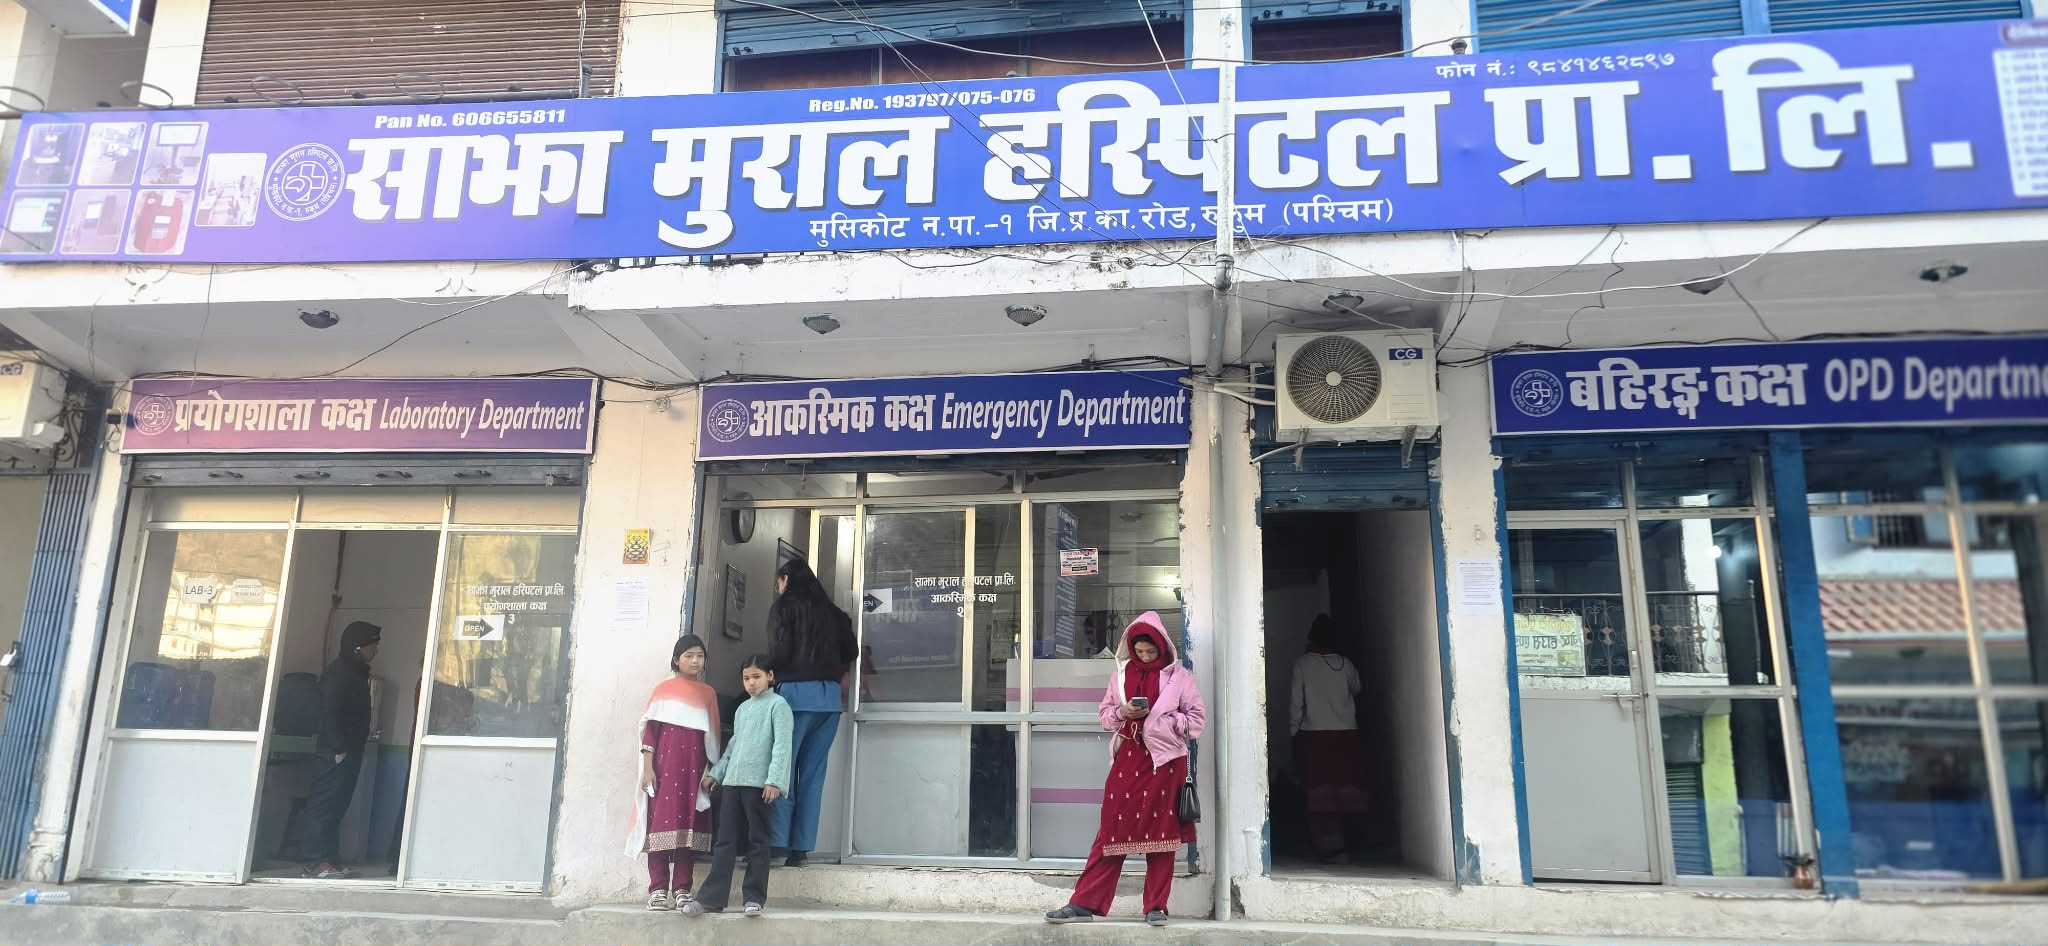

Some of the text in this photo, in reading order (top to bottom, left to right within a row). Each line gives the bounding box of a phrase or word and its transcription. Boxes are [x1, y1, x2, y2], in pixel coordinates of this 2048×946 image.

[1435, 60, 1477, 80] फोन
[1527, 52, 1676, 76] ९८४१४६२८९७
[808, 88, 1037, 113] Reg.No. 193797/075-076
[375, 109, 567, 129] Pan No. 606655811
[650, 115, 952, 250] मुराल
[978, 80, 1451, 200] हस्पिटल
[1484, 80, 1692, 186] प्रा.
[1711, 42, 1975, 172] लि.
[809, 211, 907, 240] मुसिकोट
[1282, 194, 1395, 226] (पश्चिम)
[1395, 348, 1417, 360] CG
[1711, 362, 1809, 407] कक्ष
[1824, 357, 1894, 403] OPD
[174, 389, 315, 433] प्रयोगशाला
[321, 397, 378, 432] कक्ष
[379, 396, 476, 439] Laboratory
[479, 396, 585, 439] Department
[748, 387, 877, 437] आकस्मिक
[883, 393, 936, 432] कक्ष
[941, 391, 1053, 440] Emergency
[1057, 388, 1186, 437] Department
[185, 584, 214, 595] LAB-3
[464, 624, 485, 632] OPEN
